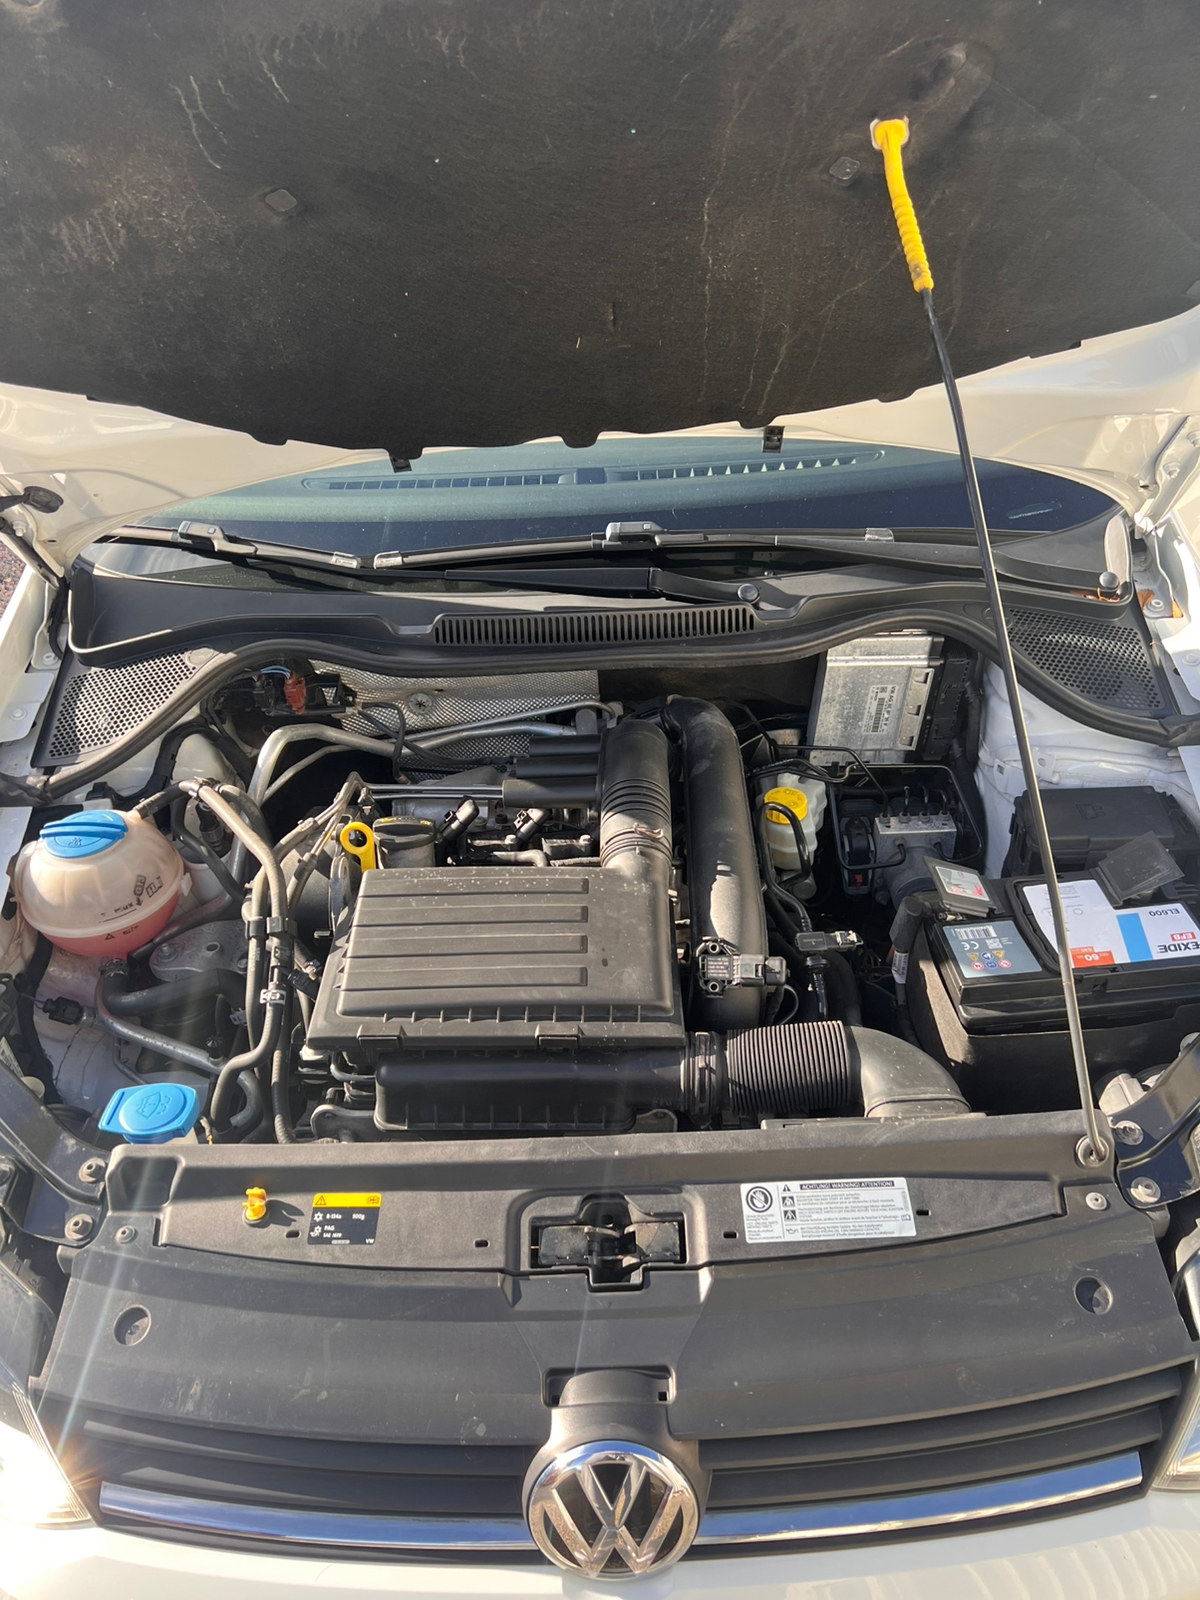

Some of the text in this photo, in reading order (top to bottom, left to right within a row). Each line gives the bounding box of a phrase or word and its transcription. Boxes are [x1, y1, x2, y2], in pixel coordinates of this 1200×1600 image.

[1148, 907, 1180, 917] EL600
[1157, 941, 1200, 954] EXIDE
[1084, 953, 1100, 962] 60
